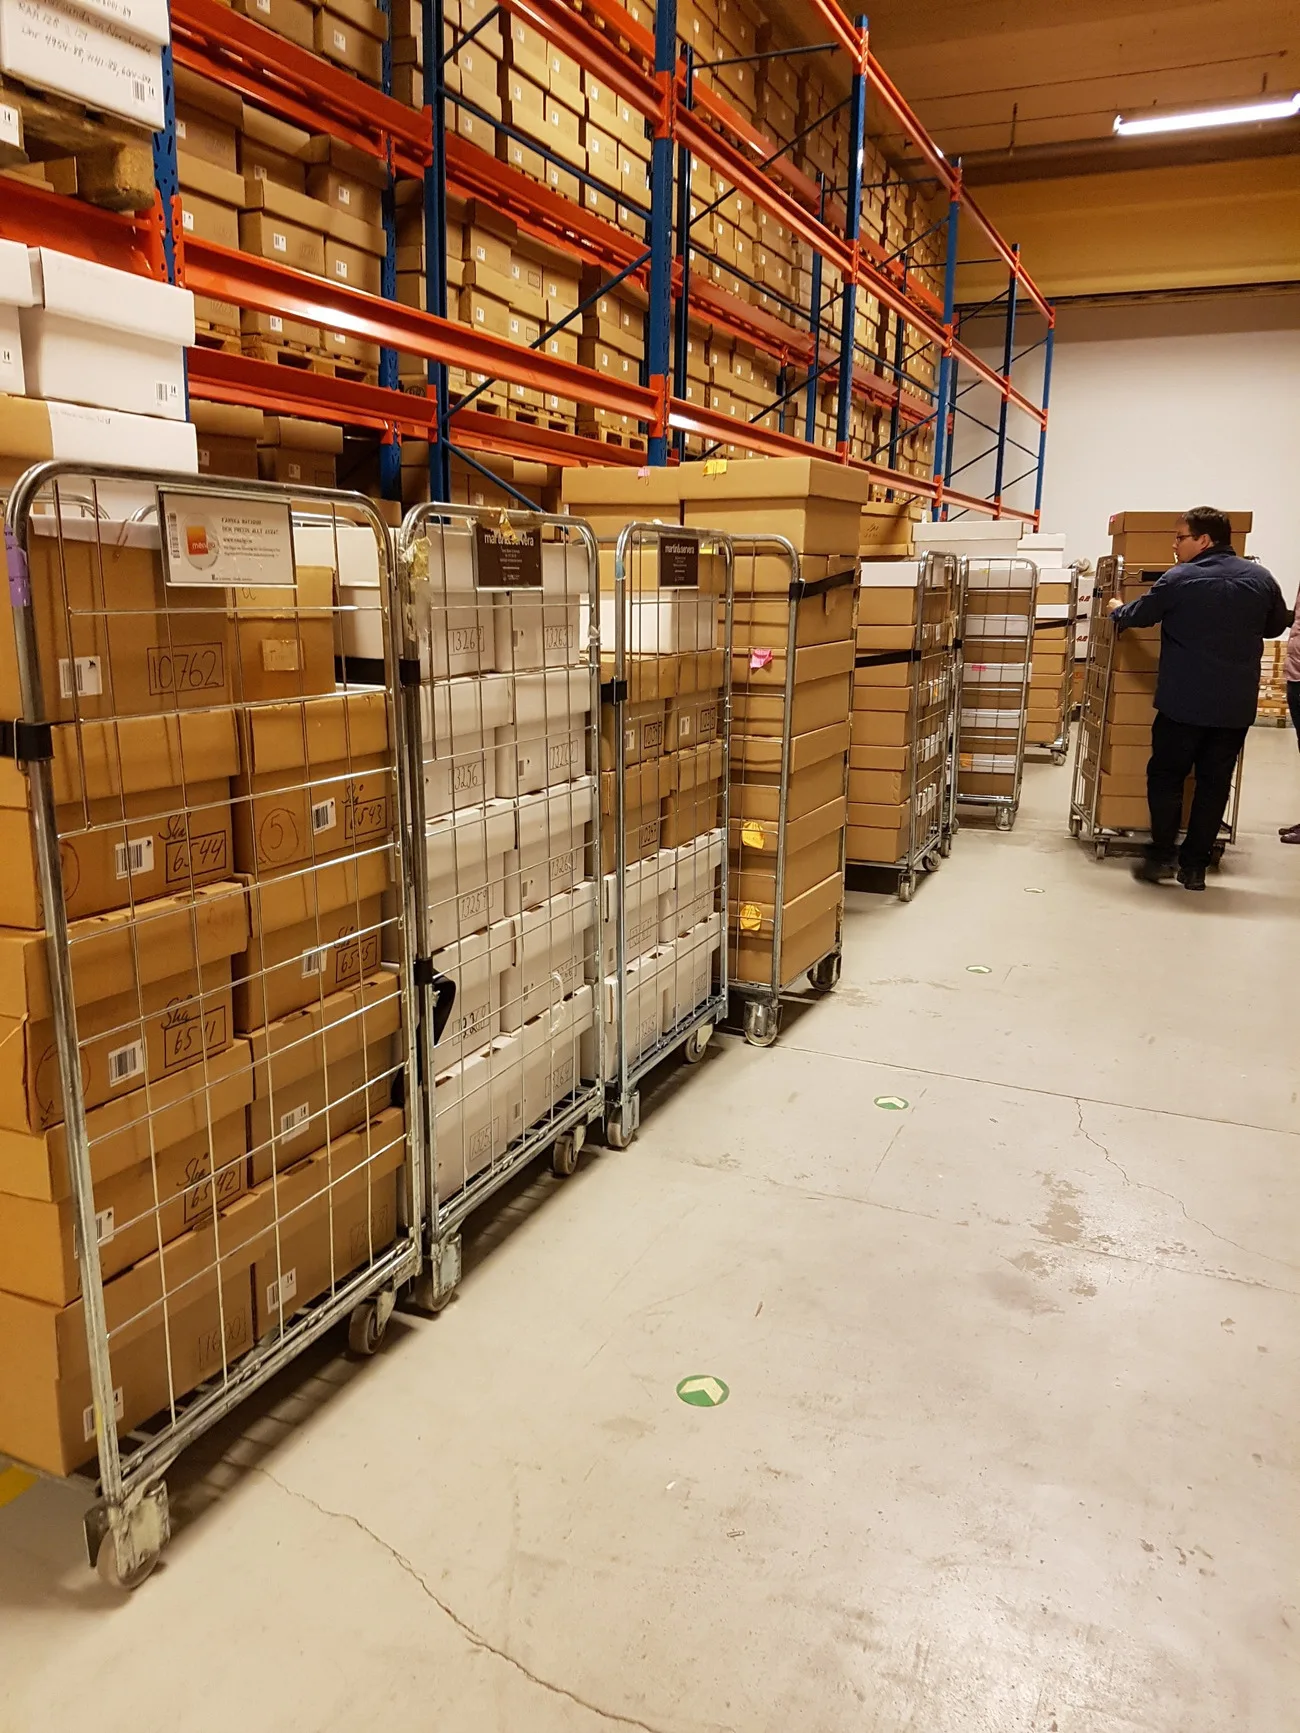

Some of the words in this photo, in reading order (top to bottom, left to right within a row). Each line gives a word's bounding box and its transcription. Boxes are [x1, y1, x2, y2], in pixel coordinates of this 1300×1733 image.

[152, 650, 219, 689] 10762
[270, 812, 284, 850] 5
[172, 838, 225, 873] 6544
[190, 1168, 236, 1208] 6542
